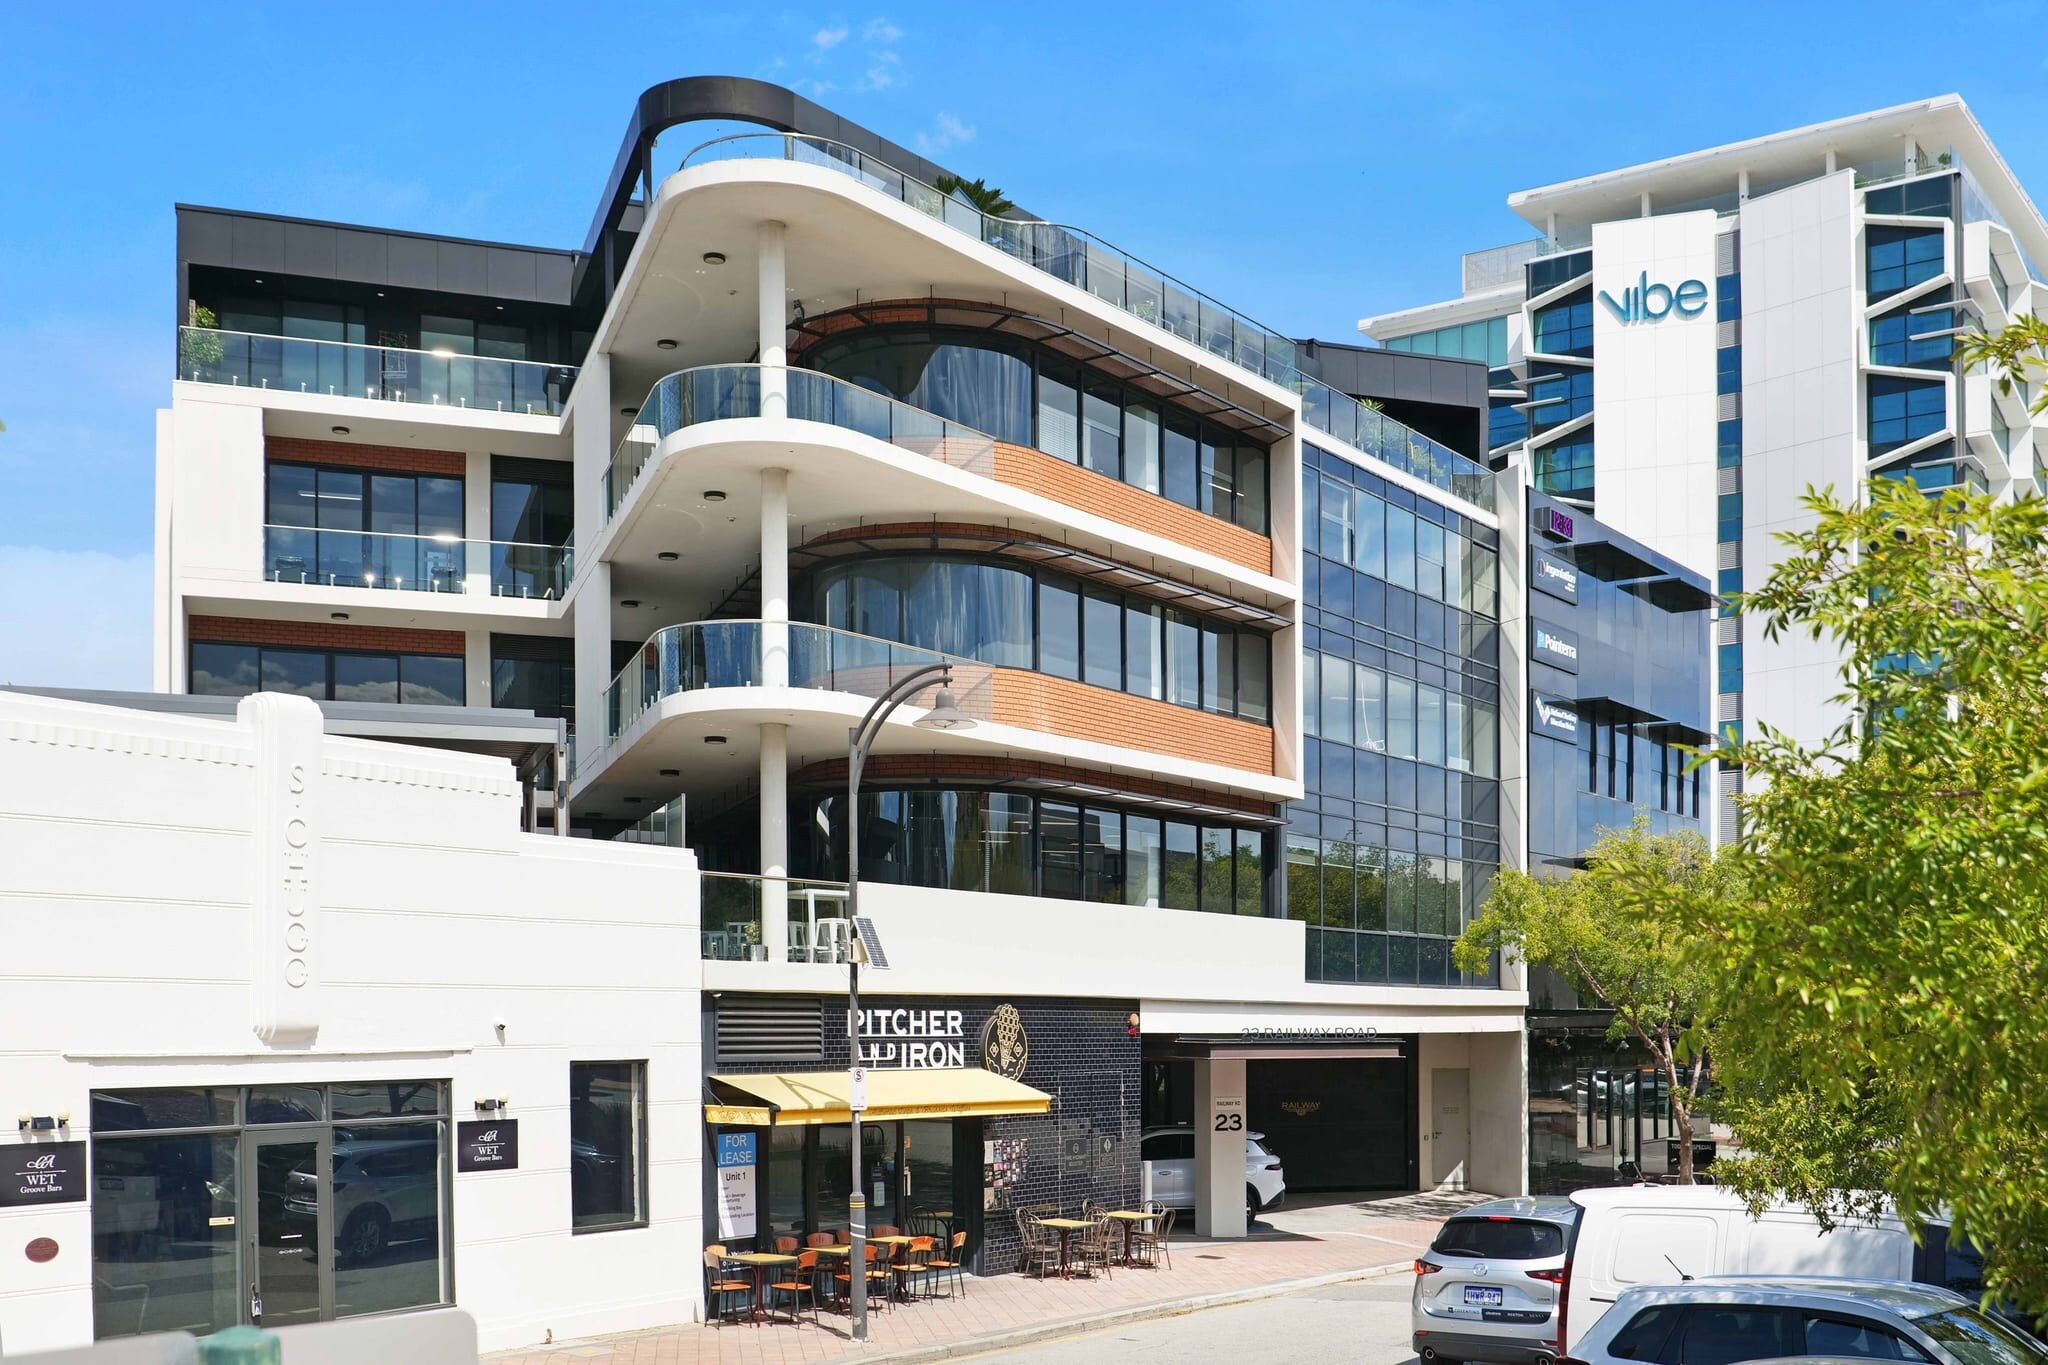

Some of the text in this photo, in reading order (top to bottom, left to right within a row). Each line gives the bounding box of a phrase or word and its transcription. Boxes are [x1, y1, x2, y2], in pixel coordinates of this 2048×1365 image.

[1598, 270, 1708, 323] vibe
[848, 1009, 963, 1037] PITCHER
[1241, 1027, 1378, 1039] 23 RAILWAY ROAD
[902, 1041, 964, 1068] IRON
[1281, 1102, 1321, 1110] RAILWAY
[1215, 1114, 1243, 1131] 23
[725, 1135, 747, 1147] FOR
[478, 1146, 499, 1155] WET
[720, 1151, 752, 1164] LEASE
[27, 1174, 57, 1186] WET
[726, 1172, 747, 1181] Unit 1
[20, 1184, 63, 1194] Groove Bars
